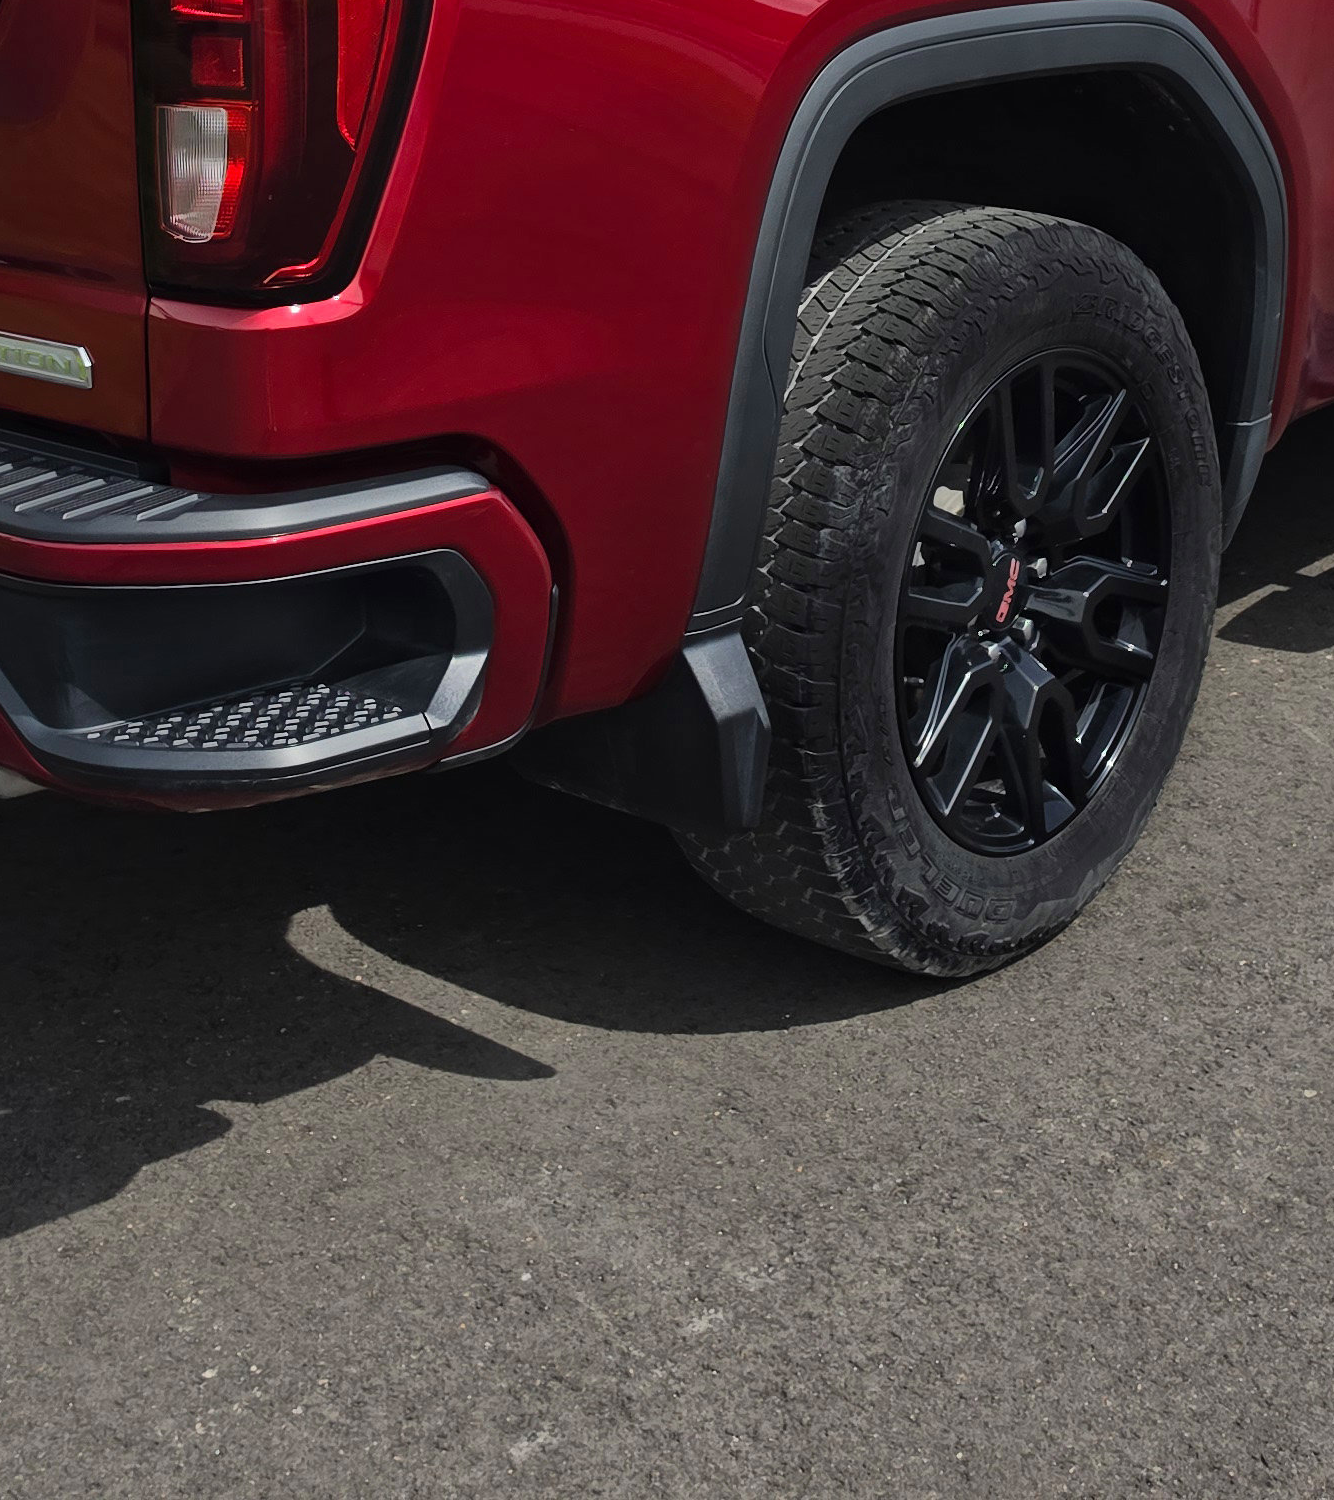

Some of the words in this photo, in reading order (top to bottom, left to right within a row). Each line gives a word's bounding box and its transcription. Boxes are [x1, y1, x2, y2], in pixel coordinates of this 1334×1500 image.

[1072, 292, 1213, 488] BRIDGESTONE
[995, 556, 1021, 624] GMC
[887, 786, 1017, 923] DUELER
